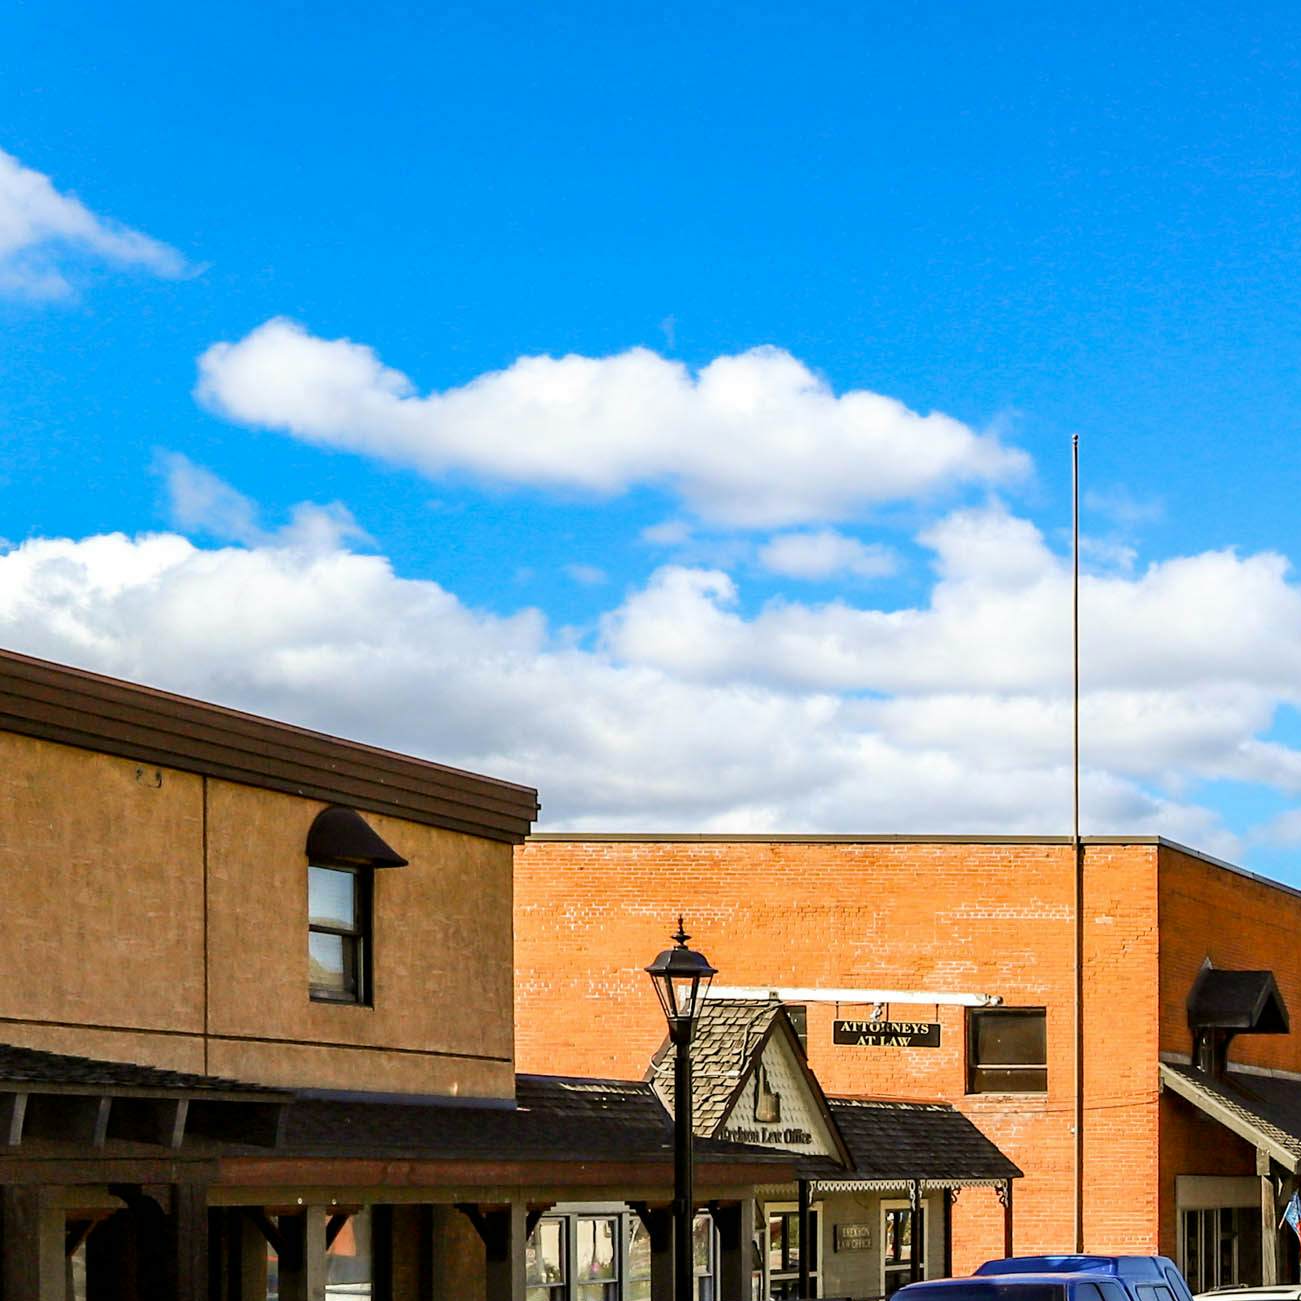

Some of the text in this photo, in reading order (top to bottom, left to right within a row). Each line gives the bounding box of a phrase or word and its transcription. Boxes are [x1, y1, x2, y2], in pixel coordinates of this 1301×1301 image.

[840, 1021, 930, 1034] ATTORNEYS
[856, 1035, 912, 1047] AT LAW
[783, 1128, 813, 1144] Office
